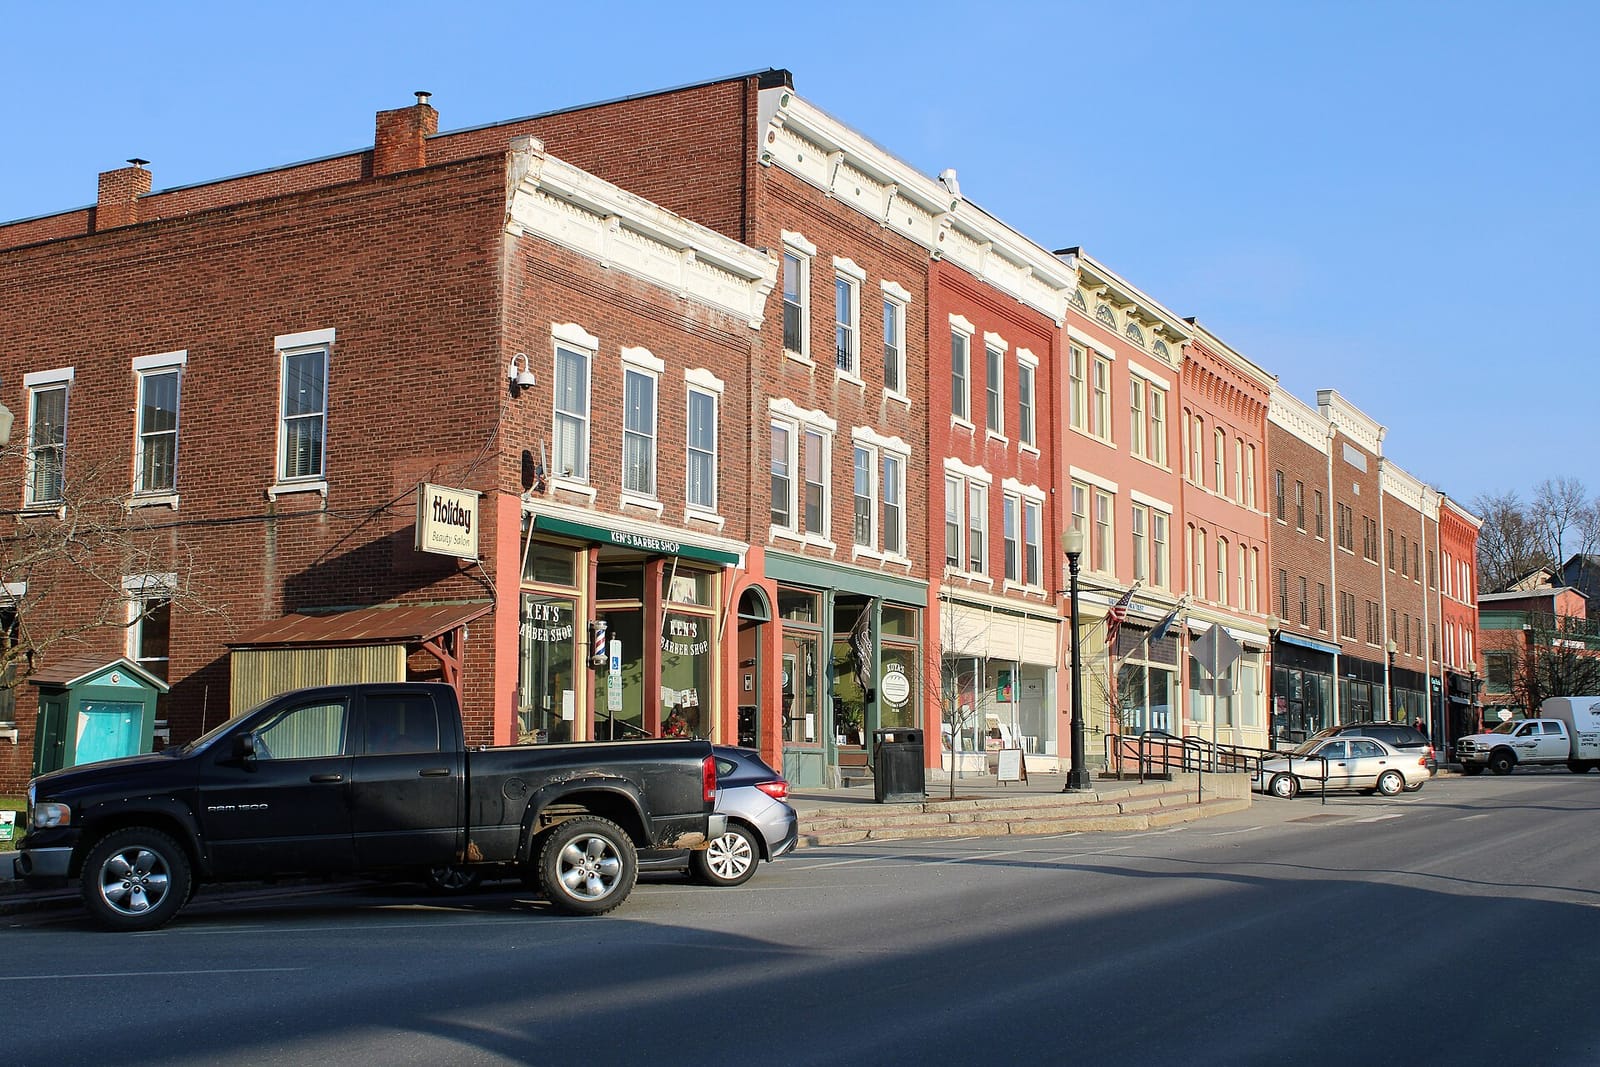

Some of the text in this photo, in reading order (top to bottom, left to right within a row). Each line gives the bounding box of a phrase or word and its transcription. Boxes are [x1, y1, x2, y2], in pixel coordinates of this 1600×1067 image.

[433, 495, 472, 535] Holiday
[432, 531, 471, 547] Beauty Salon
[611, 531, 680, 553] KEN'S BARBER SHOP
[526, 603, 560, 622] KEN'S
[550, 624, 573, 642] SHOP
[670, 619, 698, 638] KEN'S
[660, 635, 709, 656] BARBER SHOP
[238, 803, 269, 811] 1500
